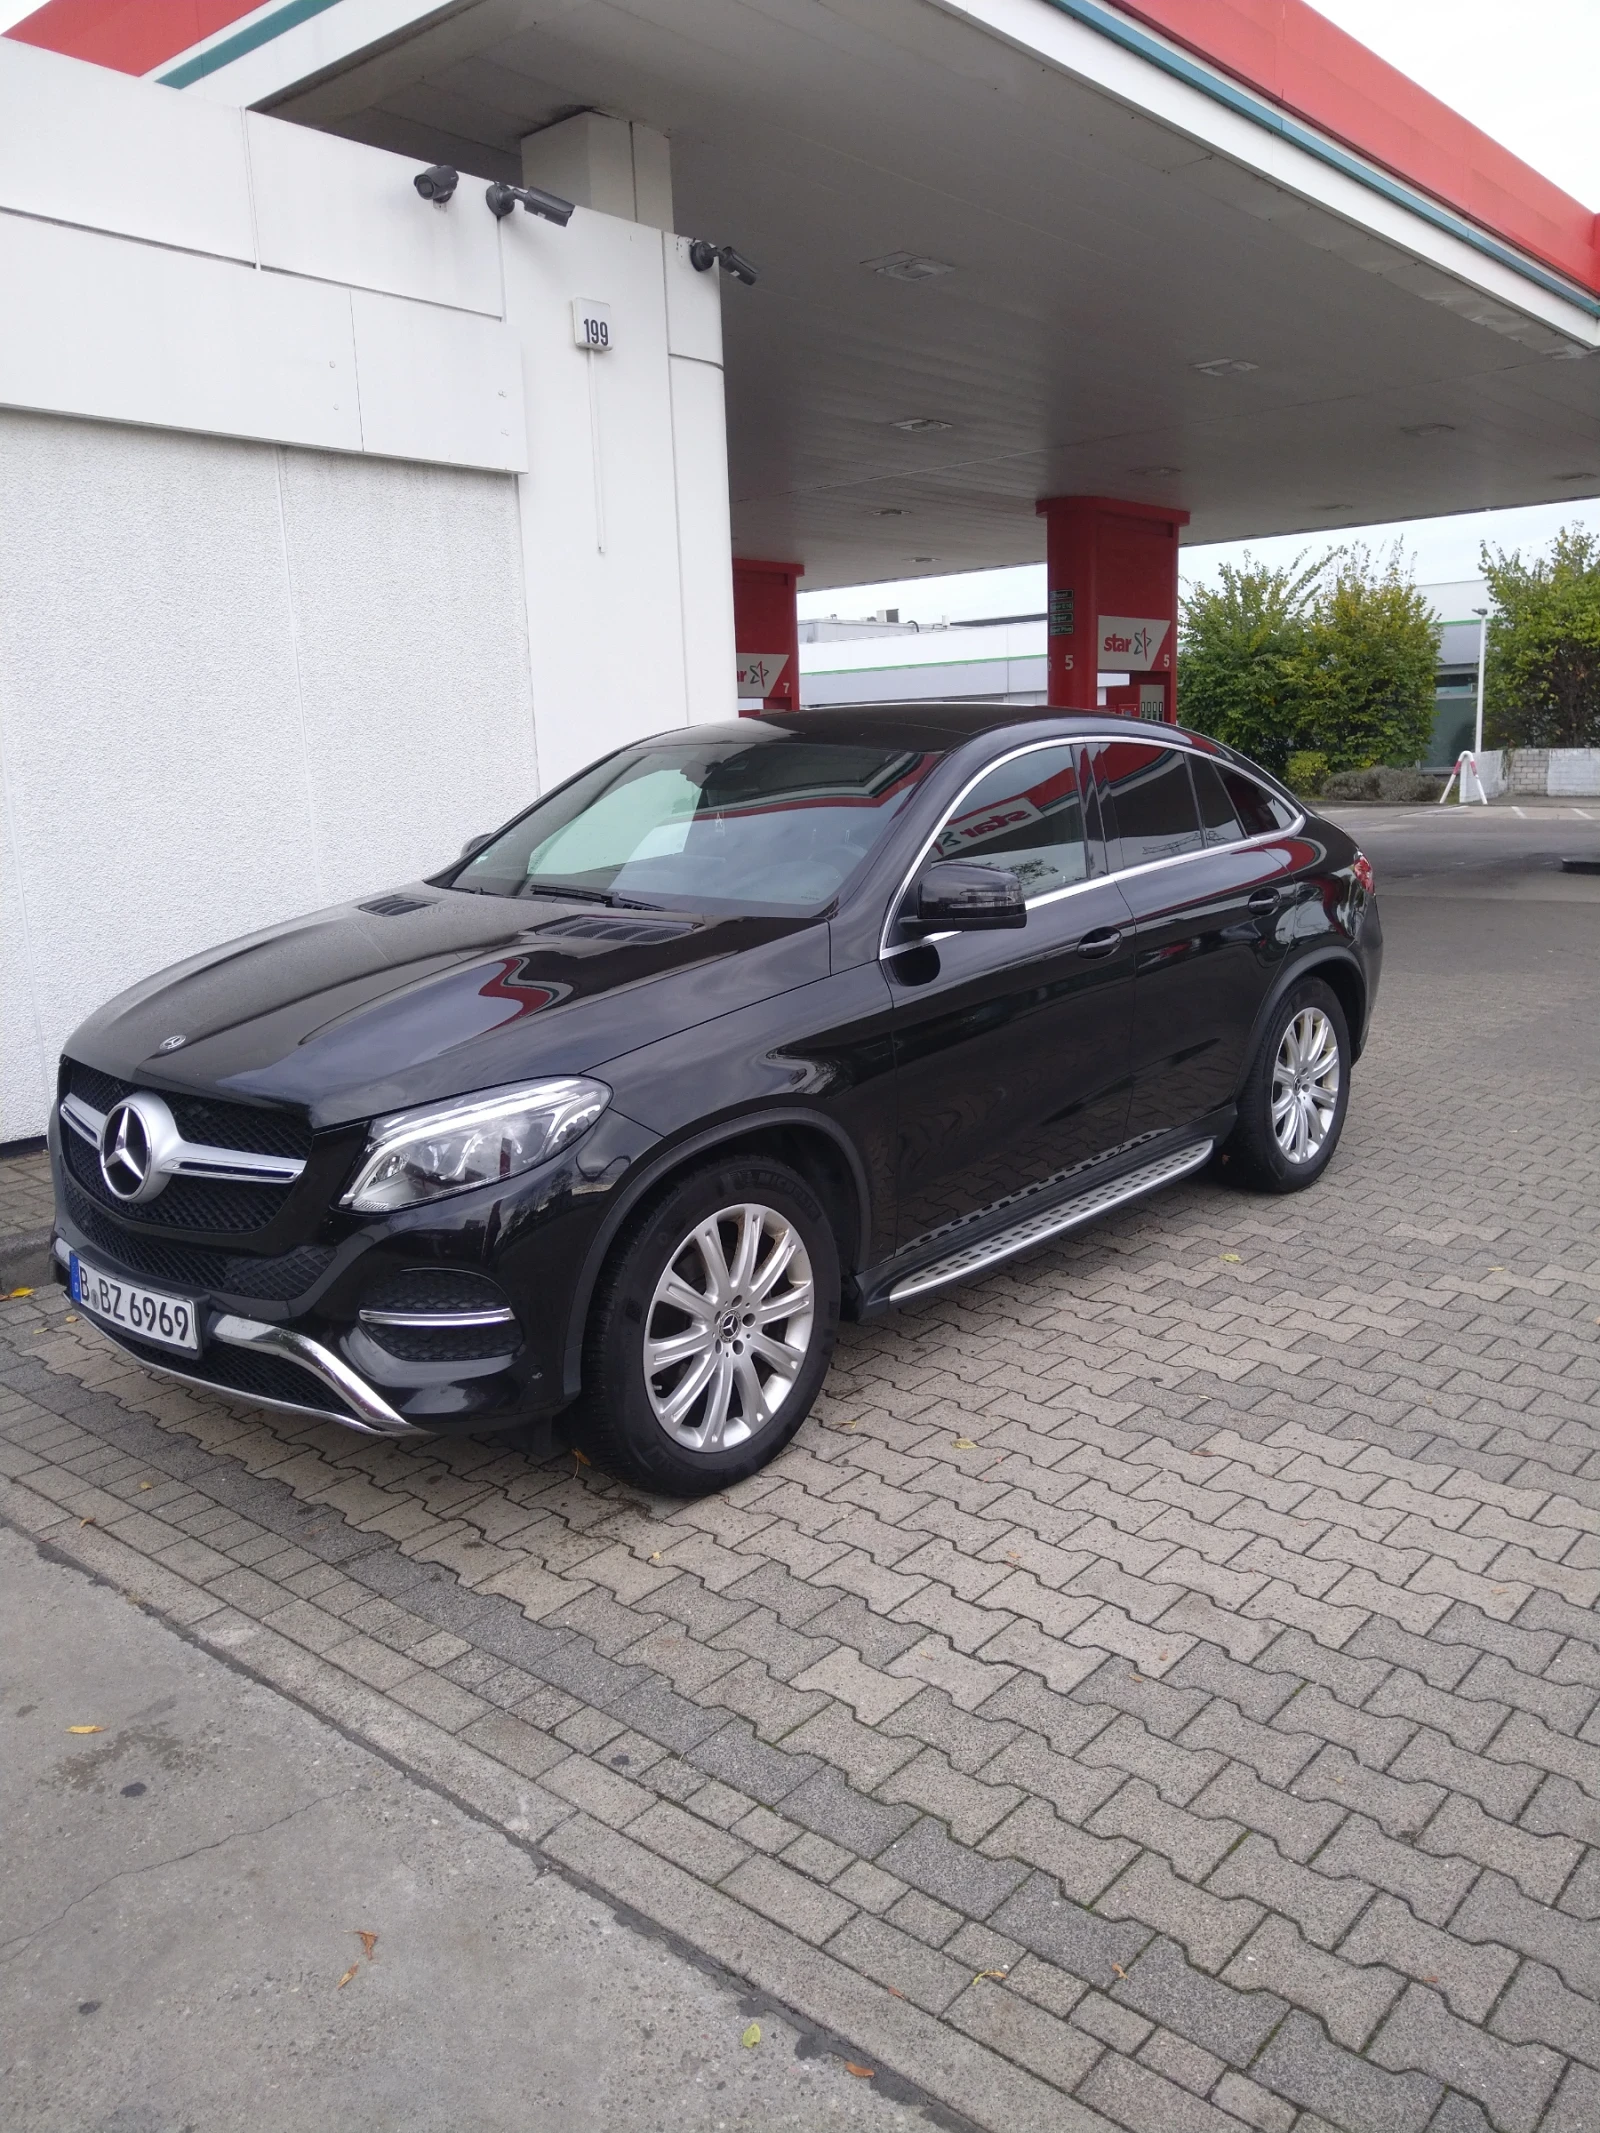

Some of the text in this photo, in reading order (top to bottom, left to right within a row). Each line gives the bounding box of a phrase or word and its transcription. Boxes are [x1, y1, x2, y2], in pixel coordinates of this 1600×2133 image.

[584, 318, 608, 346] 199
[1103, 633, 1131, 652] star
[1065, 655, 1073, 670] 5
[1163, 654, 1170, 668] 5
[783, 682, 790, 694] 7
[80, 1266, 188, 1340] B BZ 6969
